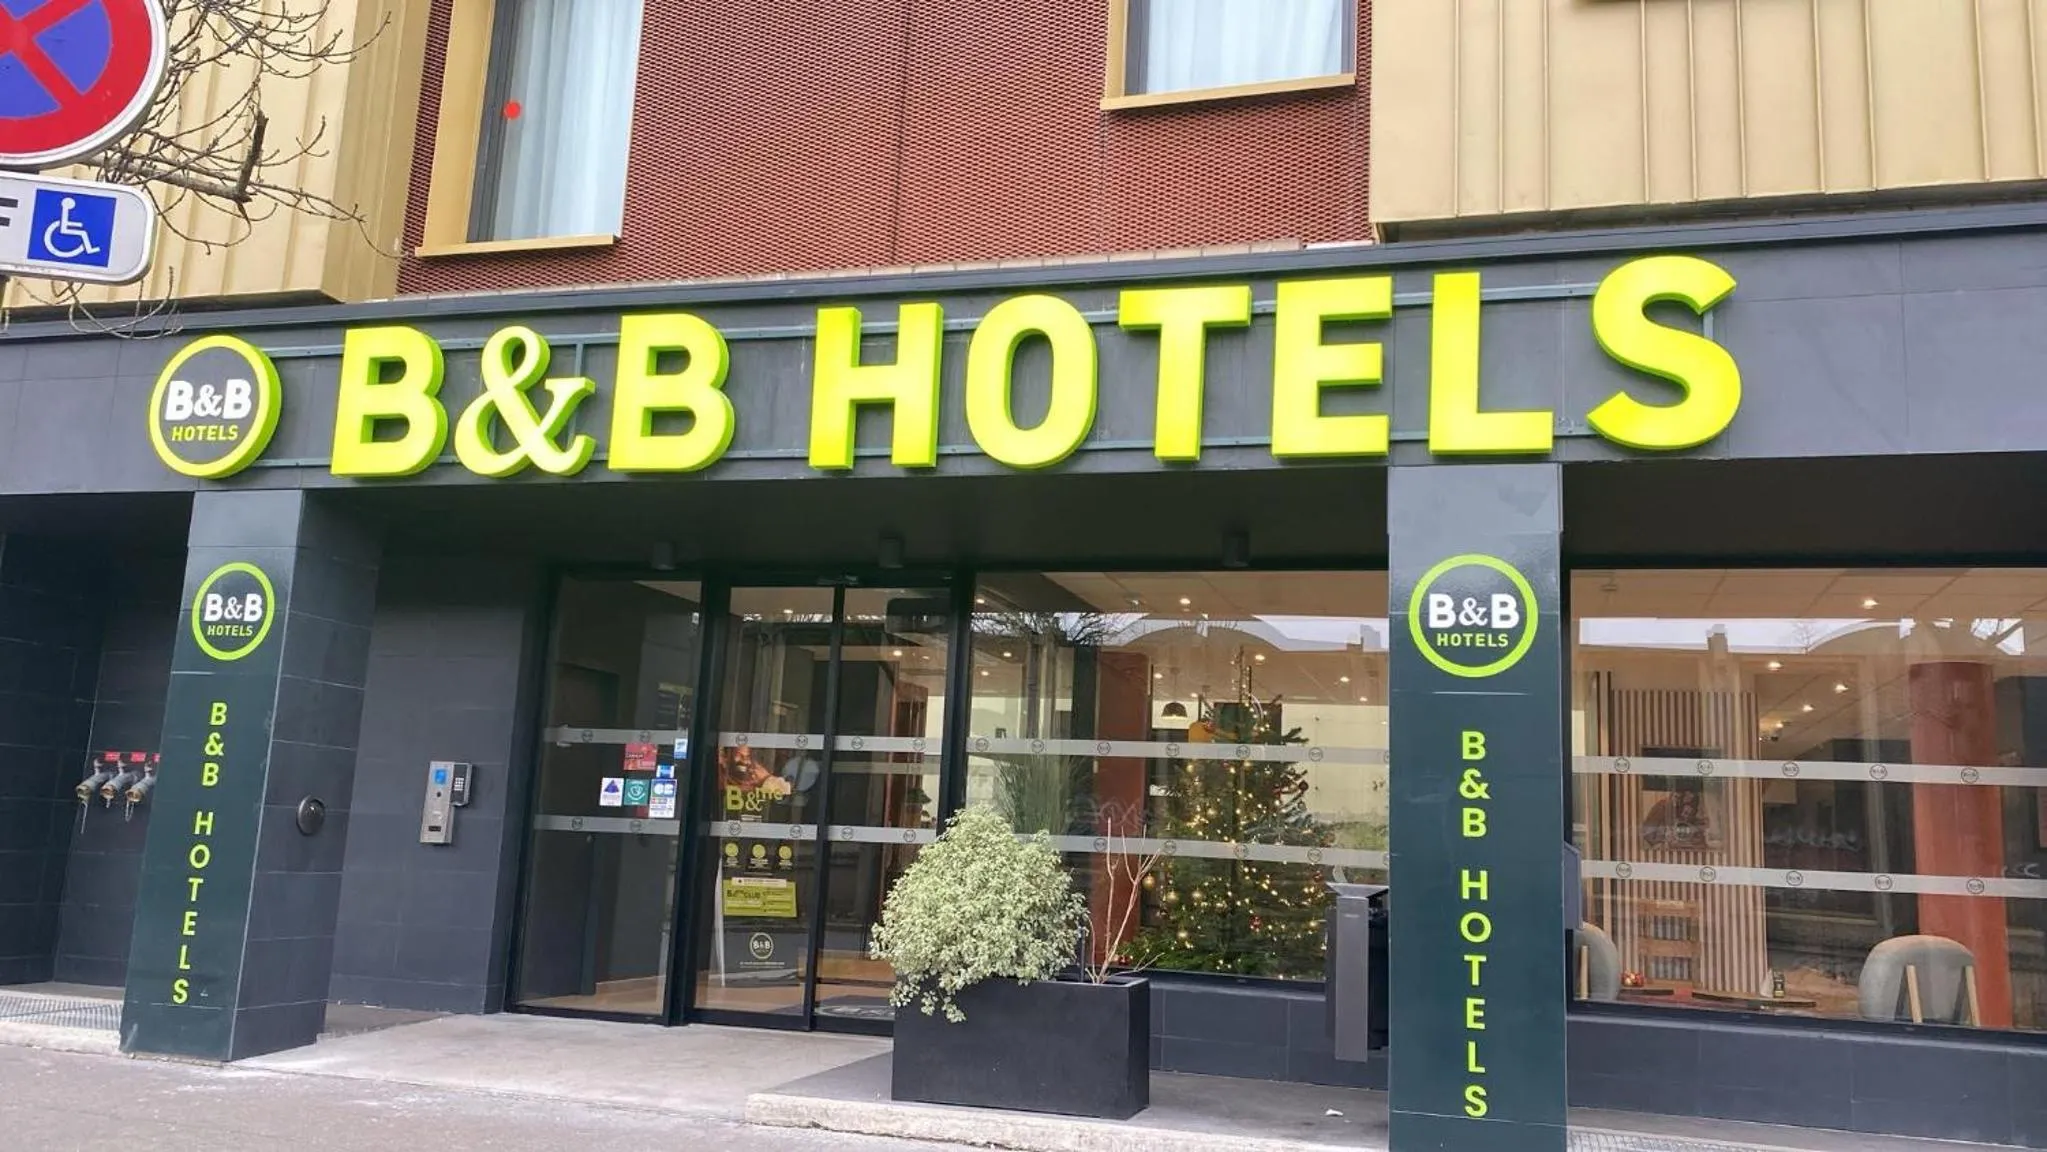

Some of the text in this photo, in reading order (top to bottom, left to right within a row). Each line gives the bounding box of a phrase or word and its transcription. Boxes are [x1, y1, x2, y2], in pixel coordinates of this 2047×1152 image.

[331, 255, 1742, 477] B&B HOTELS
[165, 378, 252, 421] B&B
[171, 424, 239, 442] HOTELS
[204, 593, 264, 622] B&B
[1428, 593, 1520, 629] B&B
[207, 624, 255, 637] HOTELS
[1436, 632, 1509, 648] HOTELS
[172, 702, 228, 1004] B&B HOTELS
[1459, 730, 1493, 1118] B&B HOTELS
